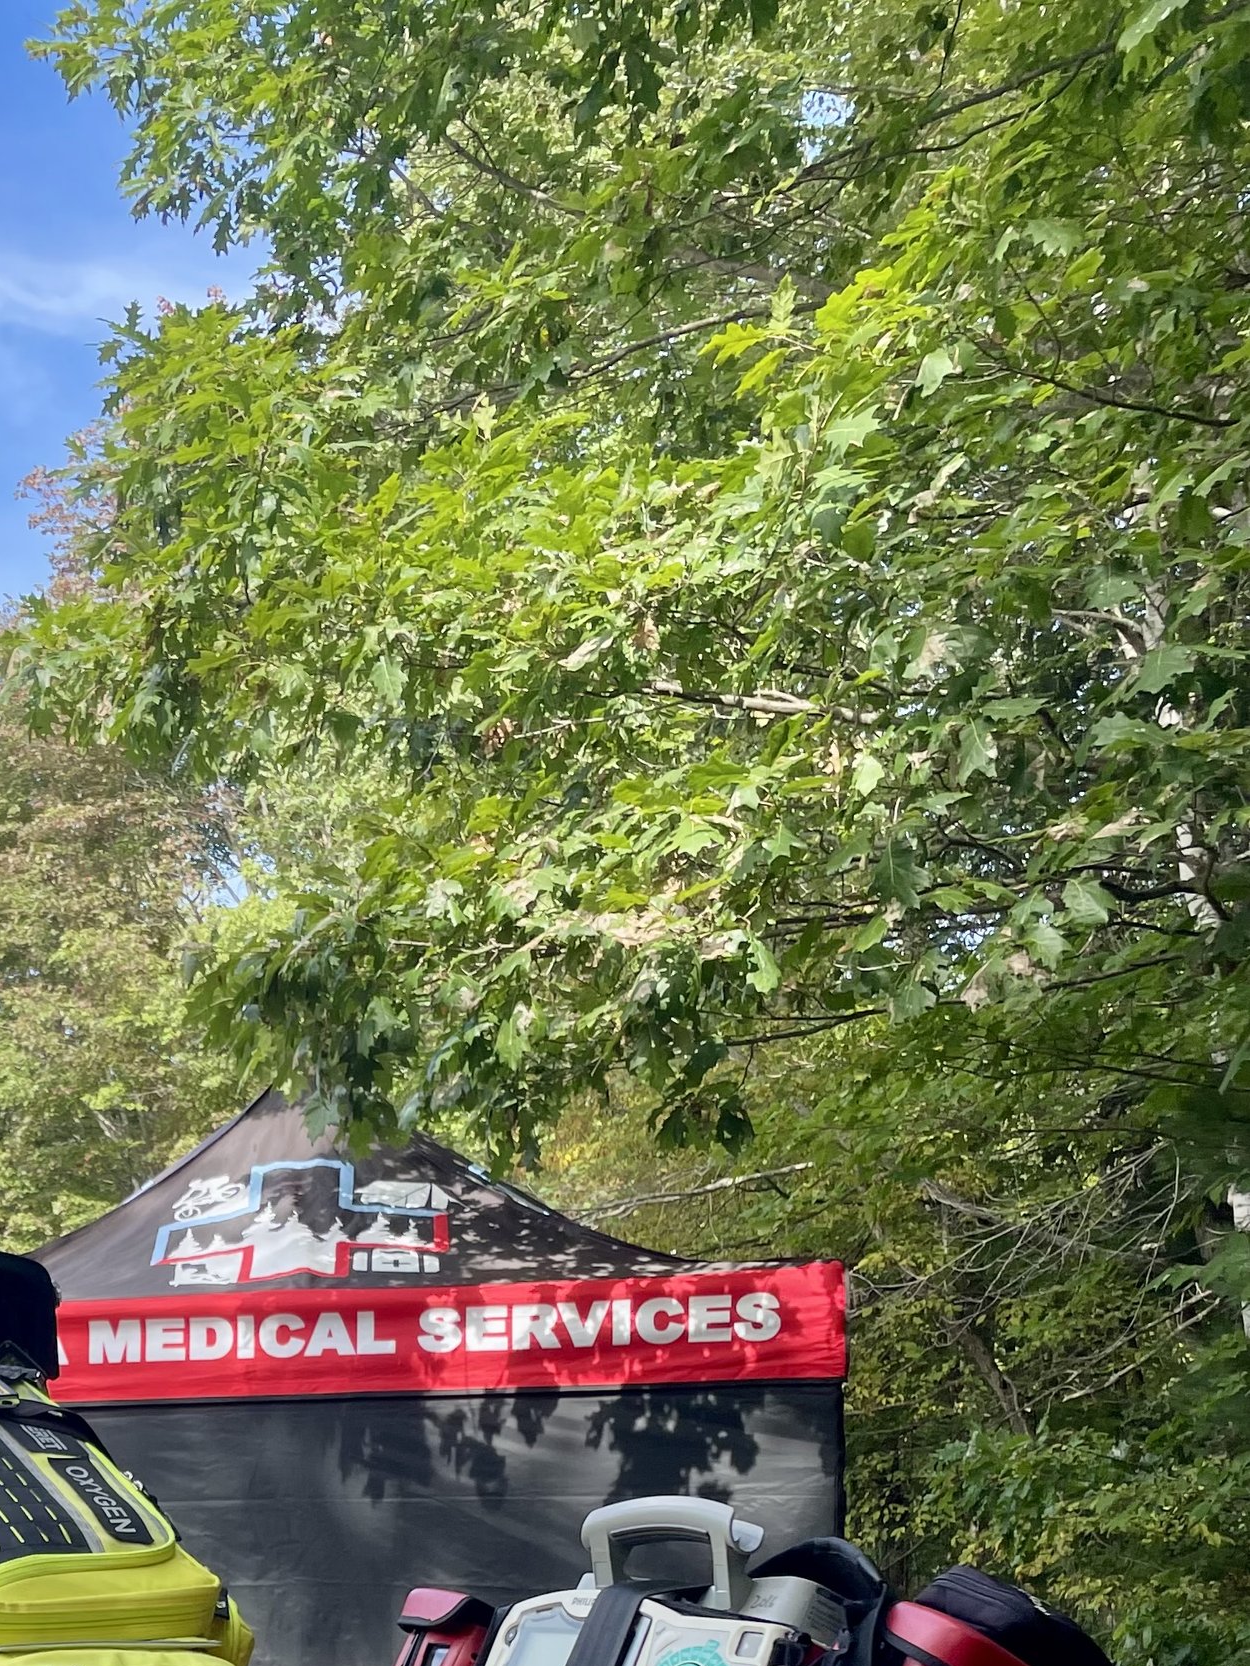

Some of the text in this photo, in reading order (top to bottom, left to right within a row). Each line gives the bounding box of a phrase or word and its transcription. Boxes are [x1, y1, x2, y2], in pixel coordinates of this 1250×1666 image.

[88, 1311, 397, 1365] MEDICAL
[417, 1292, 781, 1354] SERVICES
[65, 1466, 136, 1533] OXYGEN
